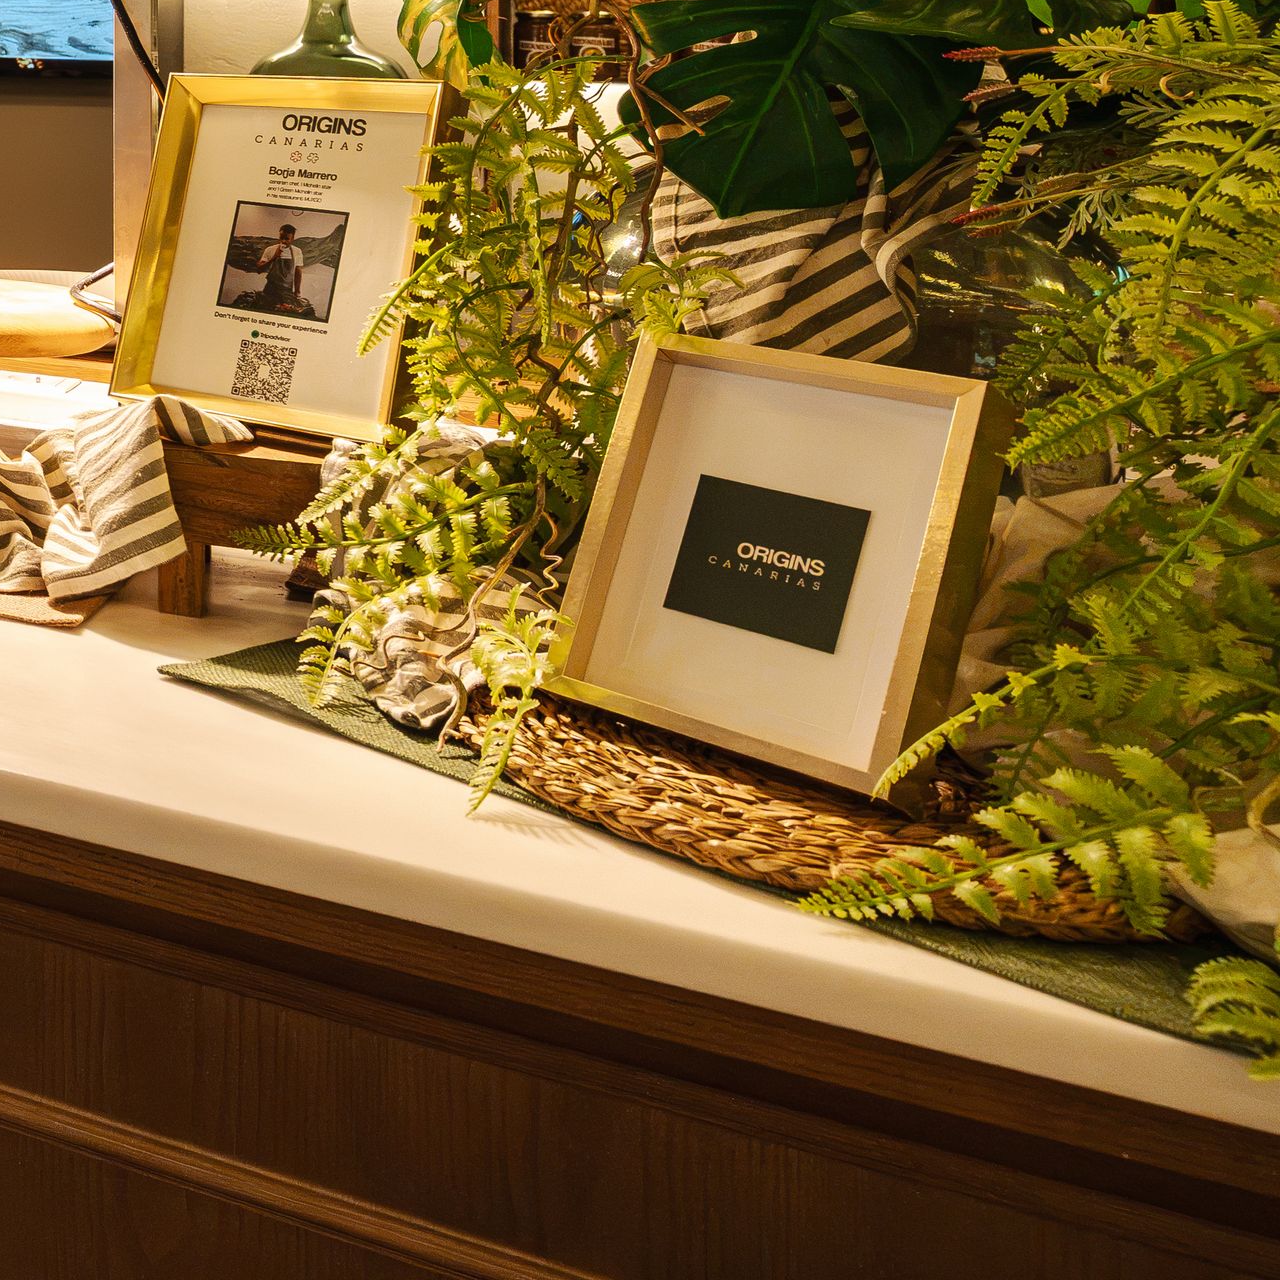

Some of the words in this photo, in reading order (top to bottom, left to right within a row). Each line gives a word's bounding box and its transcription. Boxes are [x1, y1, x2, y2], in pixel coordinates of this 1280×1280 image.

[282, 114, 367, 136] ORIGINS
[254, 134, 364, 152] CANARIAS
[269, 166, 295, 179] Borja
[297, 168, 338, 181] Marrero
[214, 311, 231, 319] Don't
[232, 313, 250, 323] forget
[258, 318, 276, 328] share
[276, 321, 291, 330] your
[292, 323, 328, 335] experience
[737, 542, 826, 577] ORIGINS
[708, 555, 821, 591] CANARIAS
